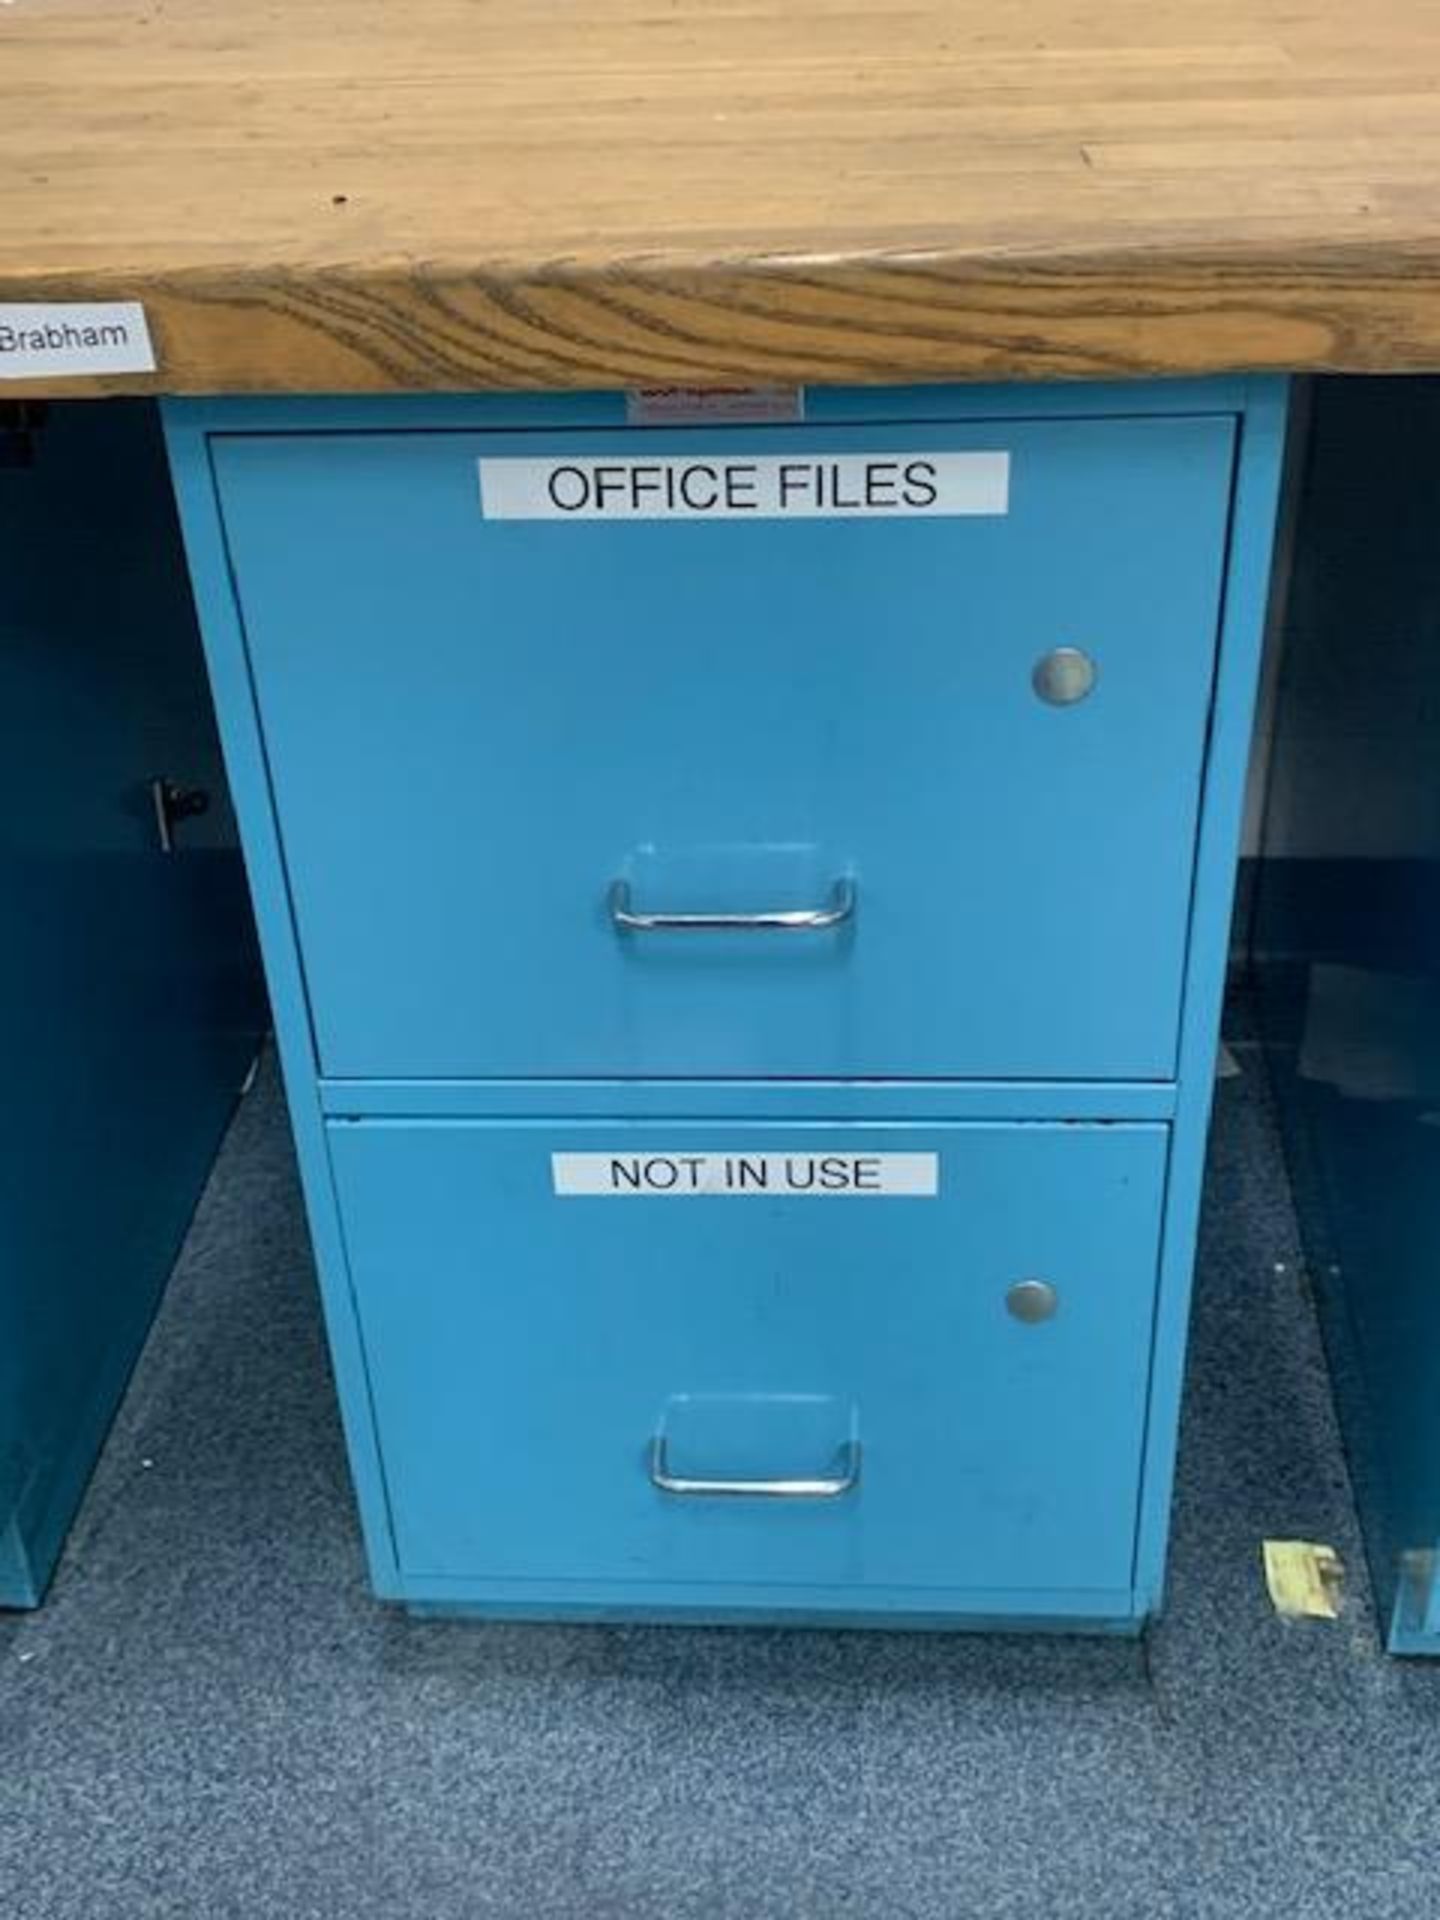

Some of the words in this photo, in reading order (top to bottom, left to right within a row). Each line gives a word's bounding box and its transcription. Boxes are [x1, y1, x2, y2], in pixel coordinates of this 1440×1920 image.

[0, 322, 128, 352] Brabham
[548, 465, 758, 512] OFFICE
[779, 462, 937, 509] FILES
[611, 1158, 708, 1189] NOT
[725, 1158, 767, 1189] IN
[785, 1158, 881, 1189] USE
